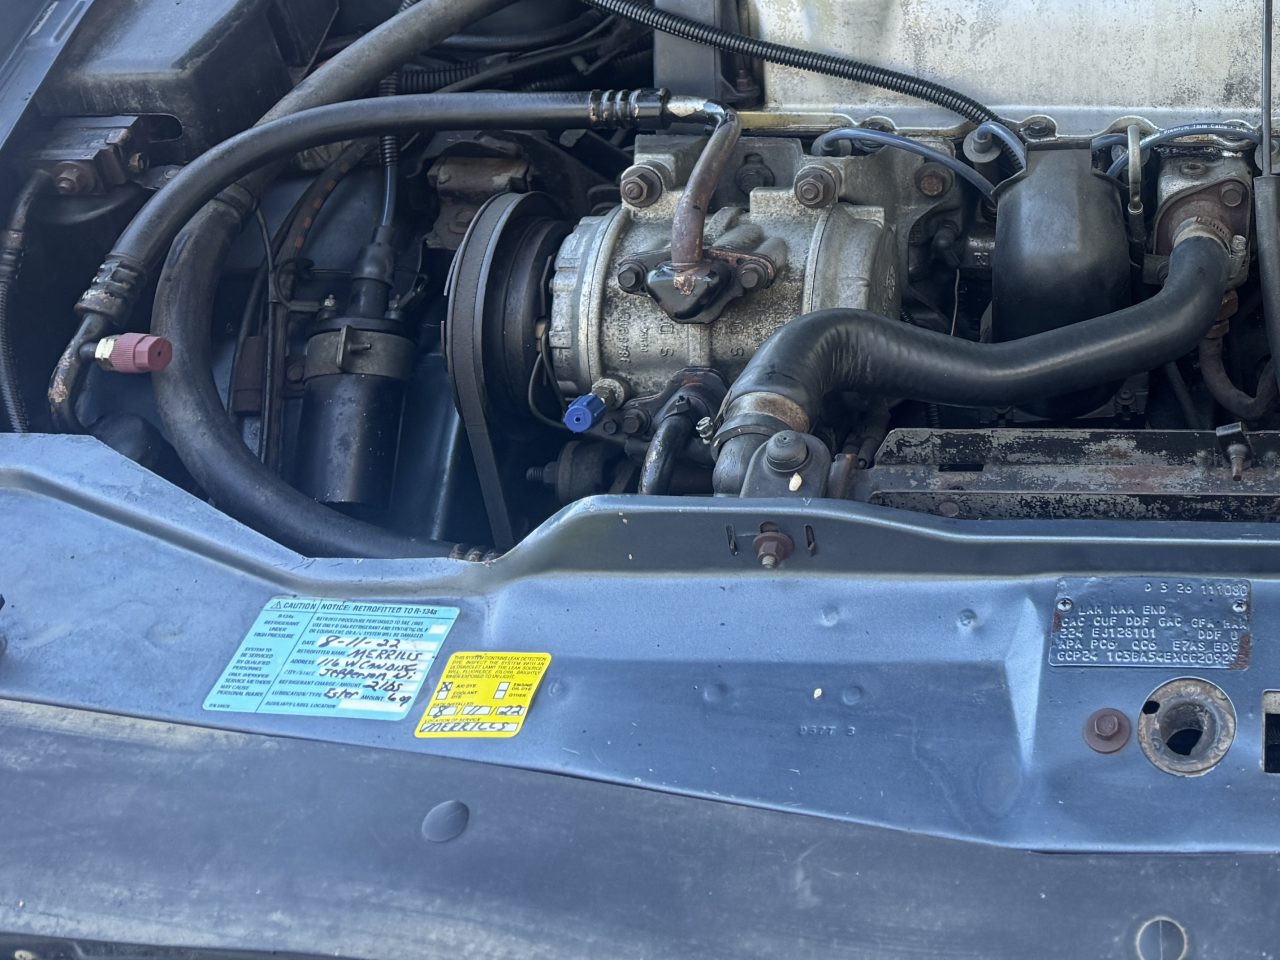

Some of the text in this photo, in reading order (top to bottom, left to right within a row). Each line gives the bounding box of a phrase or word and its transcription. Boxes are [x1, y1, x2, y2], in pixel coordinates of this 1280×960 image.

[1176, 583, 1193, 594] 26
[283, 601, 317, 609] CAUTION
[352, 604, 402, 613] RETROFITTED
[413, 607, 439, 615] R-134a
[1142, 605, 1167, 615] END
[1061, 617, 1086, 627] CAC
[1093, 616, 1118, 626] CUF
[1125, 616, 1150, 627] DDF
[1198, 630, 1222, 641] DDF
